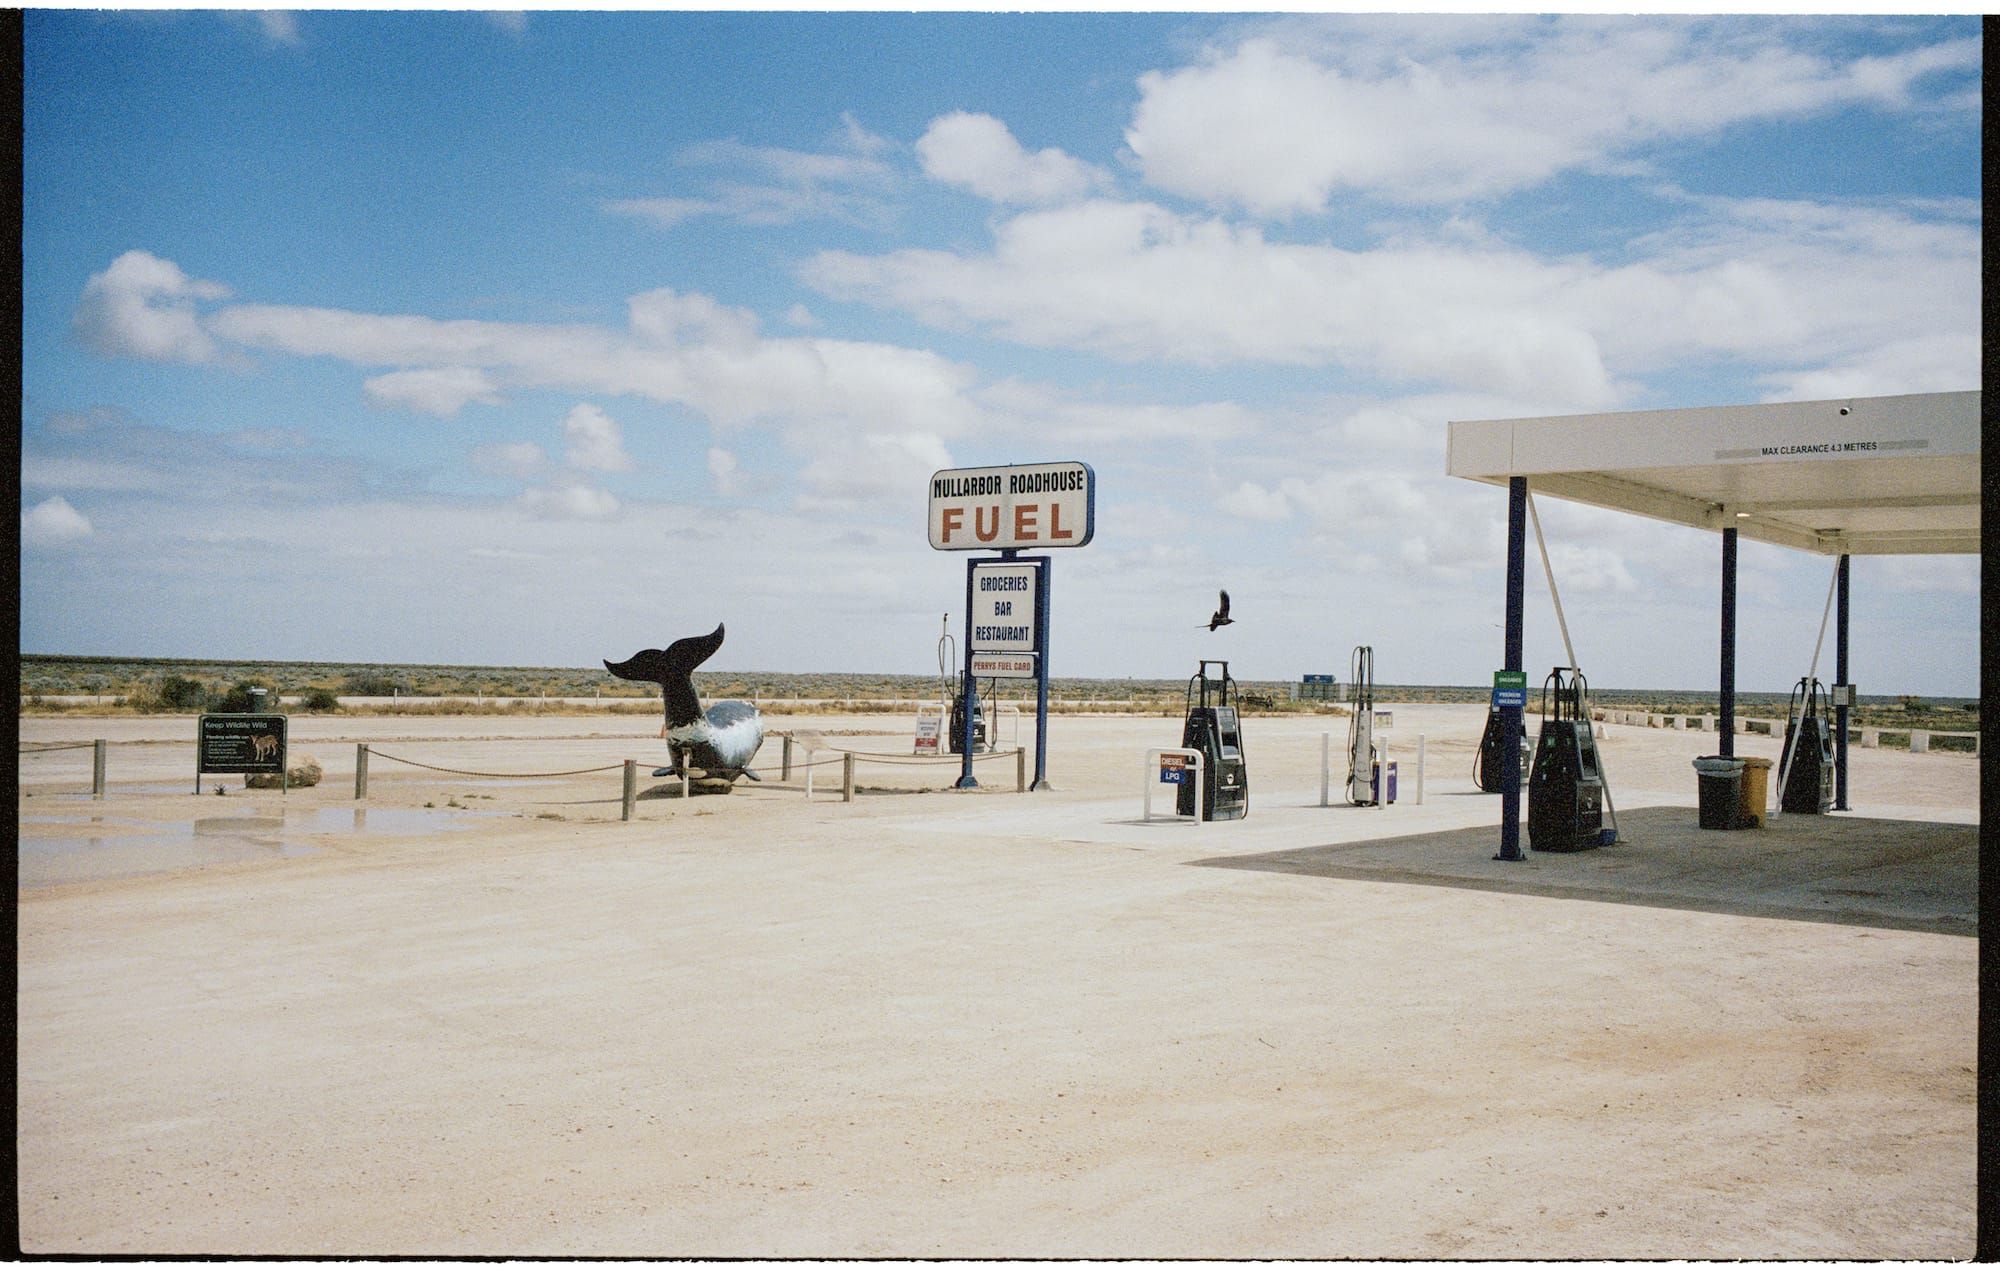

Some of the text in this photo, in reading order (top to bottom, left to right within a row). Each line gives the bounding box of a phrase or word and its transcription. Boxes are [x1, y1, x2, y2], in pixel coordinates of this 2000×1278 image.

[1761, 441, 1878, 456] MAX CLEARANCE 4.3 METRES
[934, 470, 1084, 498] NULLARBOR ROADHOUSE
[942, 503, 1073, 543] FUEL
[980, 576, 1028, 592] GROCERIES
[994, 601, 1012, 617] BAR
[975, 626, 1030, 642] RESTAURANT
[998, 661, 1012, 671] FUEL
[1013, 661, 1031, 671] CARD
[205, 721, 268, 730] Keep Wildlife Wild
[1161, 757, 1185, 766] DIESEL
[1165, 772, 1181, 780] LPG
